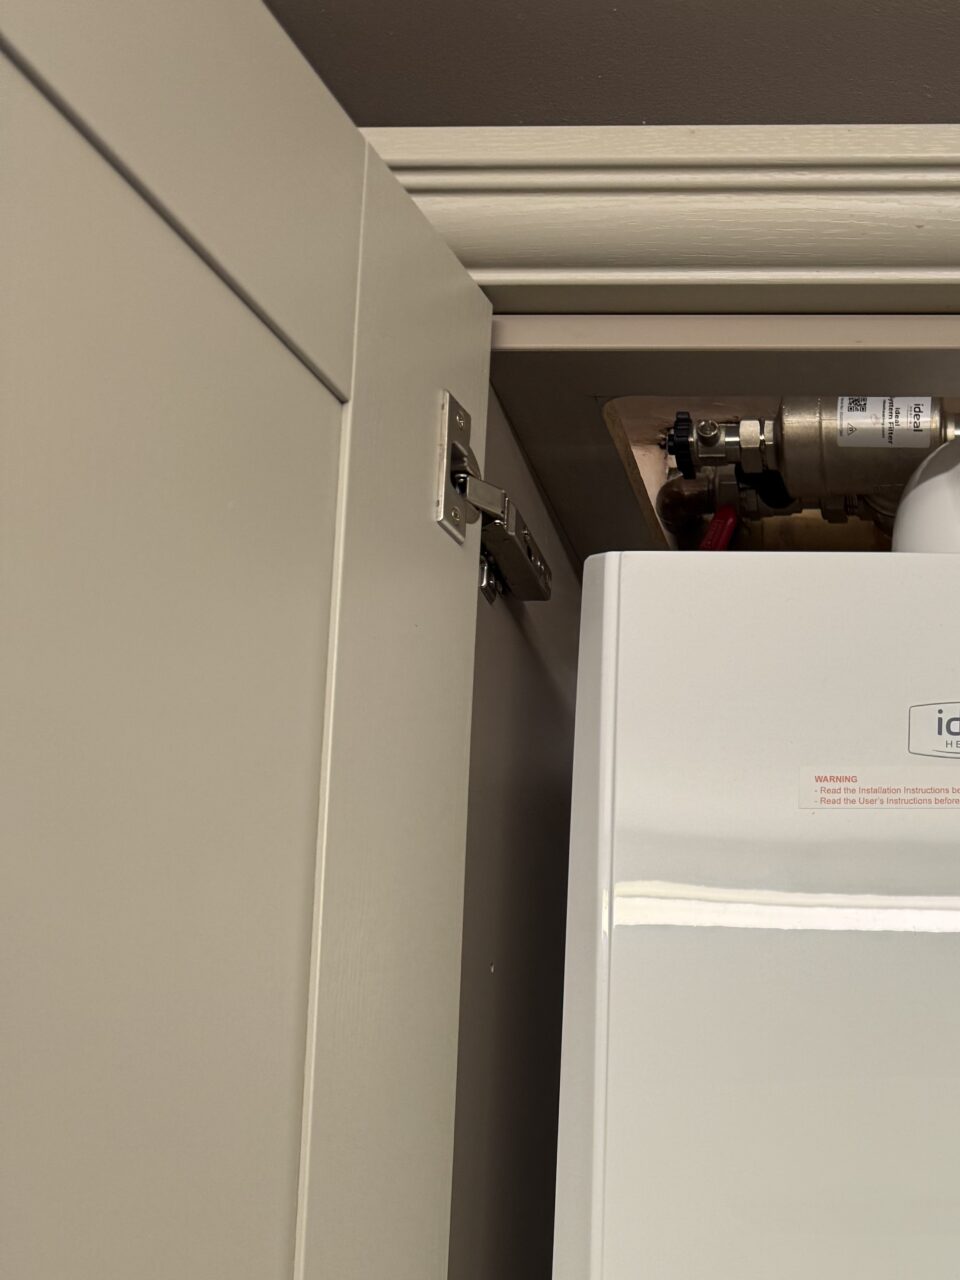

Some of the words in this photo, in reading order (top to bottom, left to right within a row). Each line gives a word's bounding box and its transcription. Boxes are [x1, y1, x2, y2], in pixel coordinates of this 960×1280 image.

[913, 403, 924, 433] ideal
[814, 775, 858, 784] WARNING
[820, 786, 842, 795] Read
[843, 786, 857, 795] the
[858, 786, 902, 795] Installation
[903, 786, 950, 795] Instructions
[820, 796, 842, 805] Read
[843, 796, 857, 805] the
[858, 796, 884, 805] User's
[886, 796, 933, 805] Instructions
[934, 796, 960, 805] before
